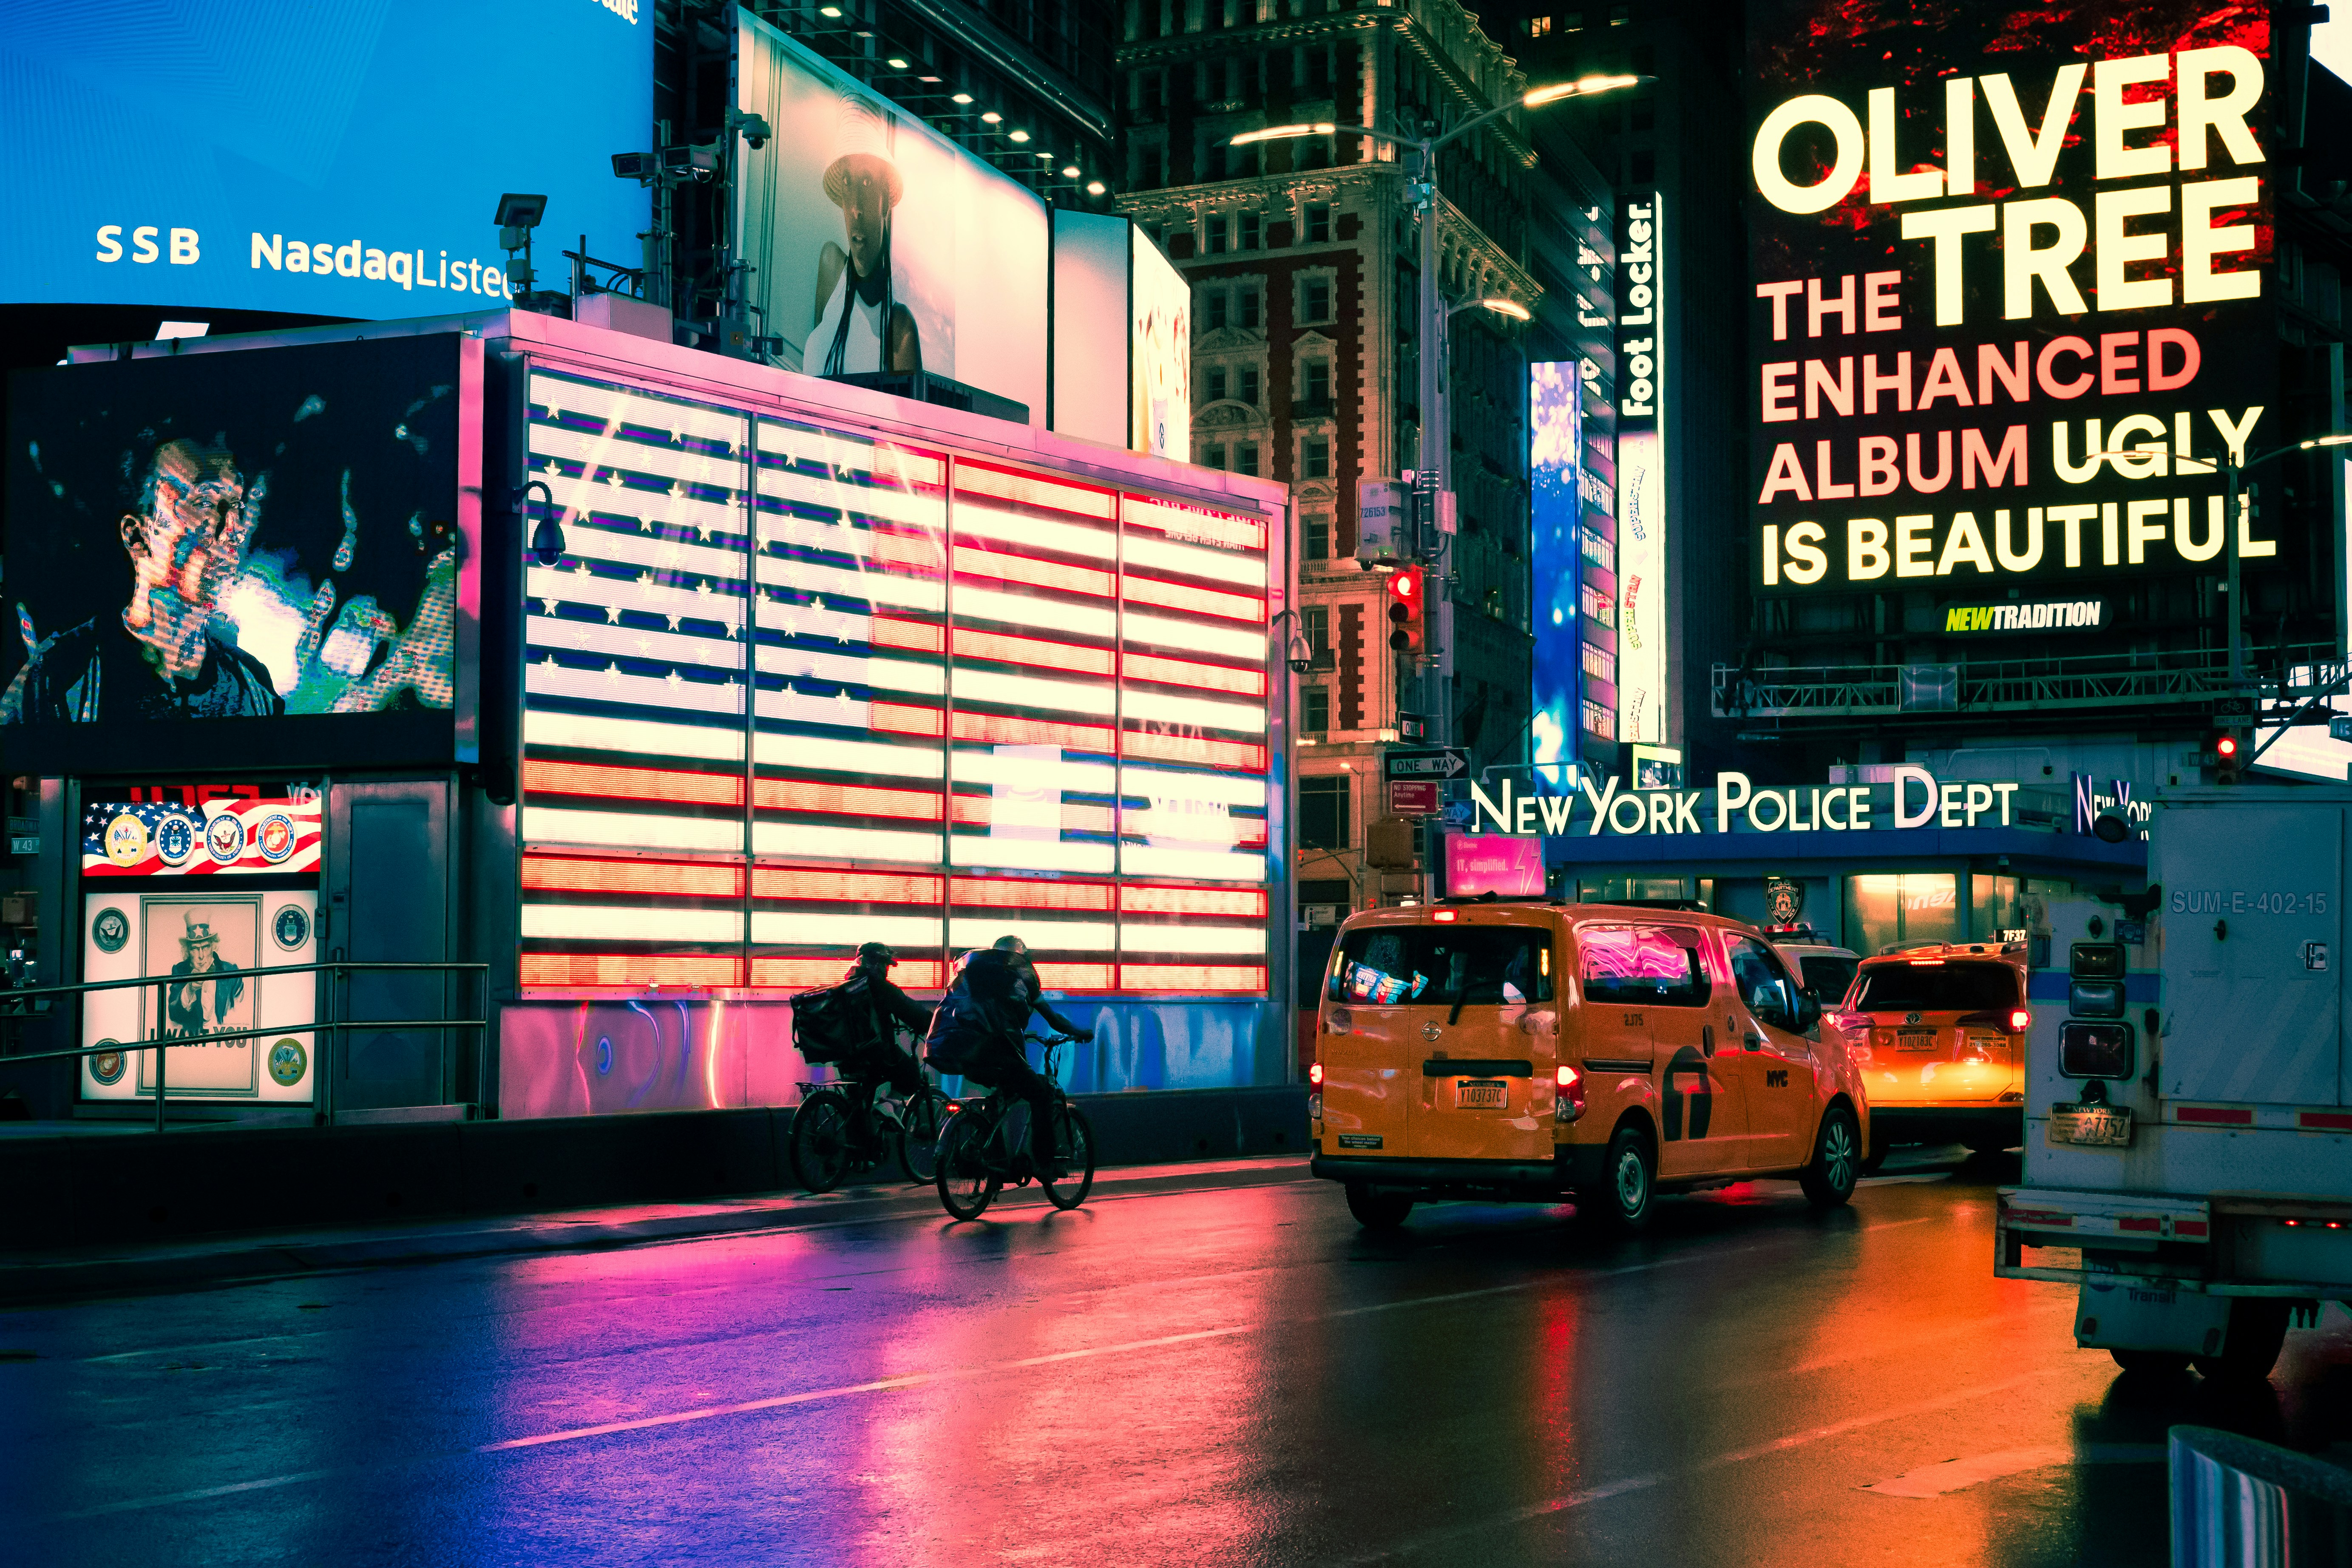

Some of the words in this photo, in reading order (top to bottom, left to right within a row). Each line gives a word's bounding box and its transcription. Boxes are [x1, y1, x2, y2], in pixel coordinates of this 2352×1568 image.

[1752, 45, 2266, 214] OLIVER
[1901, 176, 2261, 326] TREE
[1756, 270, 1902, 340] THE
[1622, 337, 1653, 416] Foot
[1761, 327, 2201, 422] ENHANCED
[1758, 425, 2028, 504] ALBUM
[2052, 406, 2264, 484] UGLY
[1762, 521, 1827, 585] IS
[1847, 493, 2277, 581] BEAUTIFUL
[2233, 716, 2250, 724] LANE
[1396, 760, 1421, 773] ONE
[1432, 758, 1457, 771] WAY
[1470, 779, 1573, 836] NEW
[1580, 775, 1701, 836] YORK
[1718, 771, 1871, 833] POLICE
[1893, 766, 2019, 830] DEPT
[1445, 808, 1465, 818] WAY
[13, 840, 20, 851] W
[22, 839, 32, 851] 43
[1457, 859, 1468, 873] IT,
[1470, 859, 1509, 874] simplified.
[2171, 890, 2327, 915] SUM-E-402-15
[2003, 930, 2026, 941] 7F37
[213, 1026, 247, 1049] YOU
[1767, 1070, 1788, 1088] NYC
[1461, 1089, 1501, 1103] Y103737C
[2095, 1117, 2125, 1137] 7752
